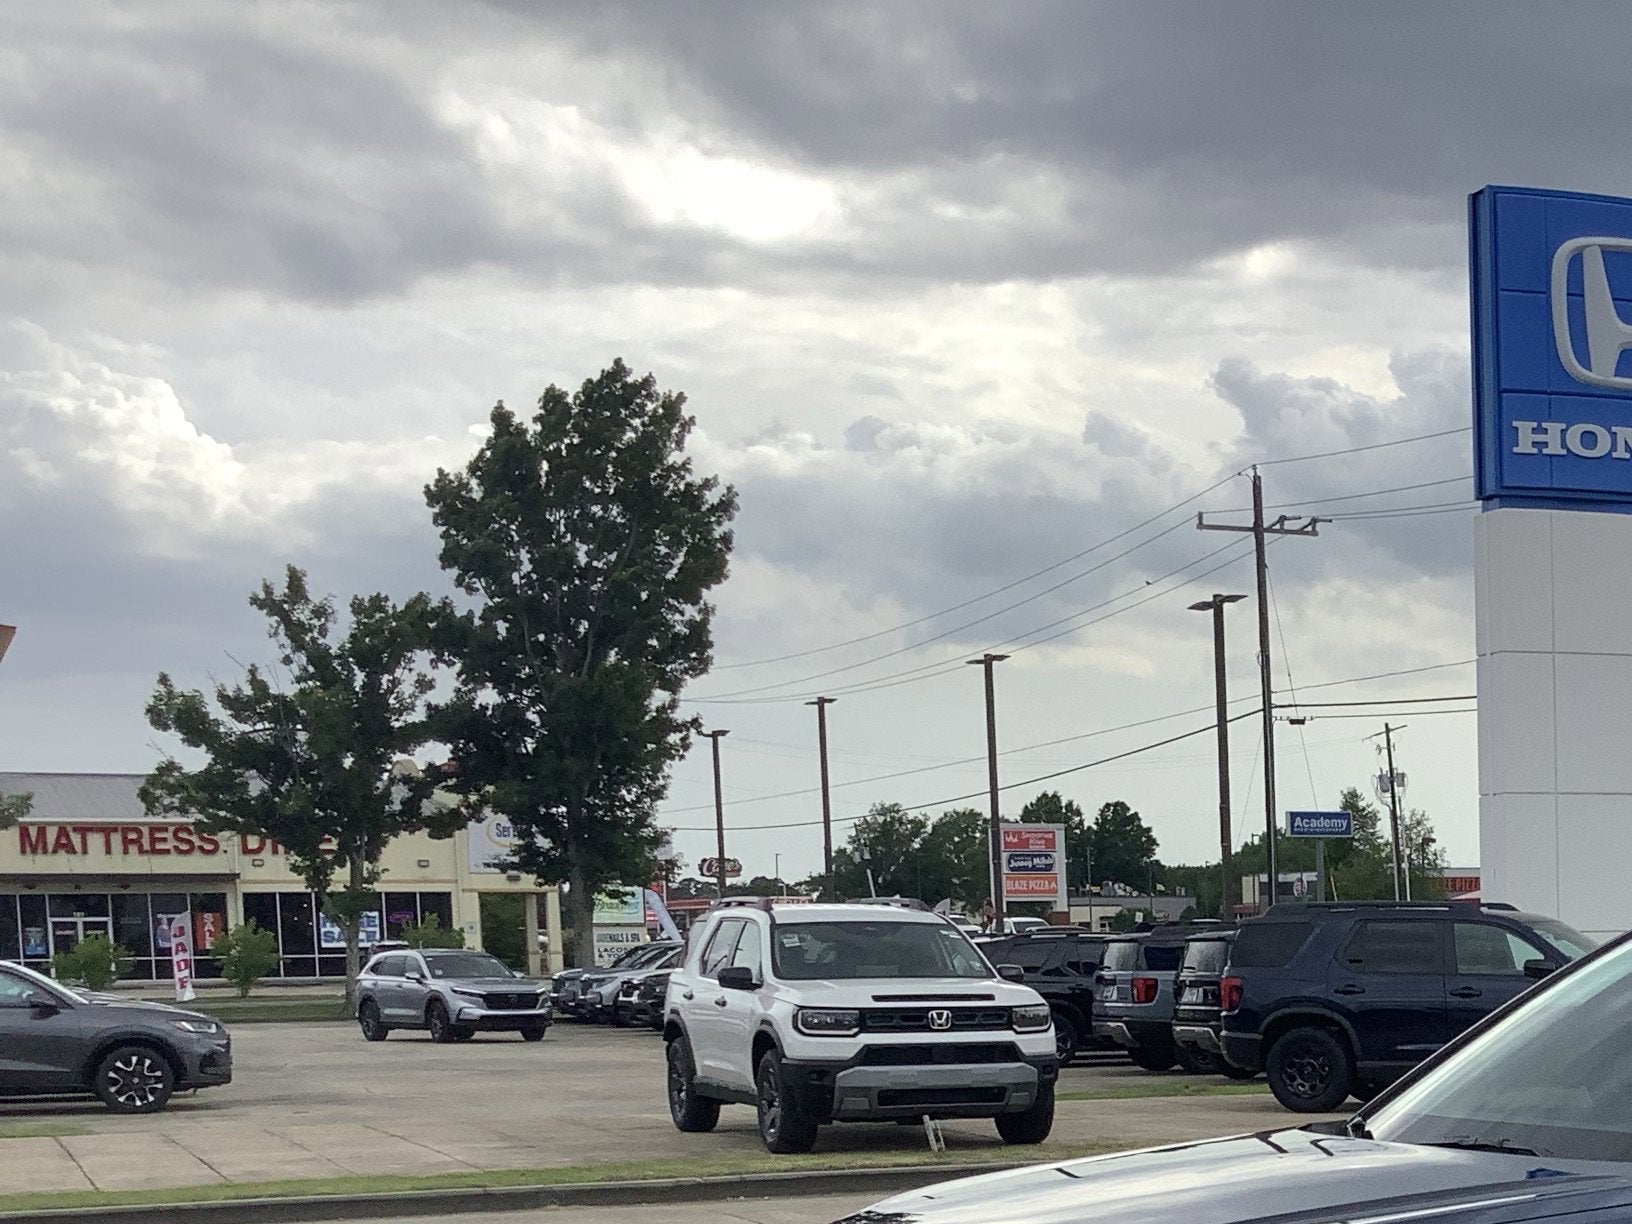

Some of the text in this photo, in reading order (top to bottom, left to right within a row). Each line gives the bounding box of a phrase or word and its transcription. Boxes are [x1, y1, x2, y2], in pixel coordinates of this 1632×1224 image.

[1294, 816, 1348, 831] Academy
[19, 825, 219, 855] MATTRESS
[1007, 880, 1049, 891] BLAZE PIZZA
[173, 926, 189, 989] JADE
